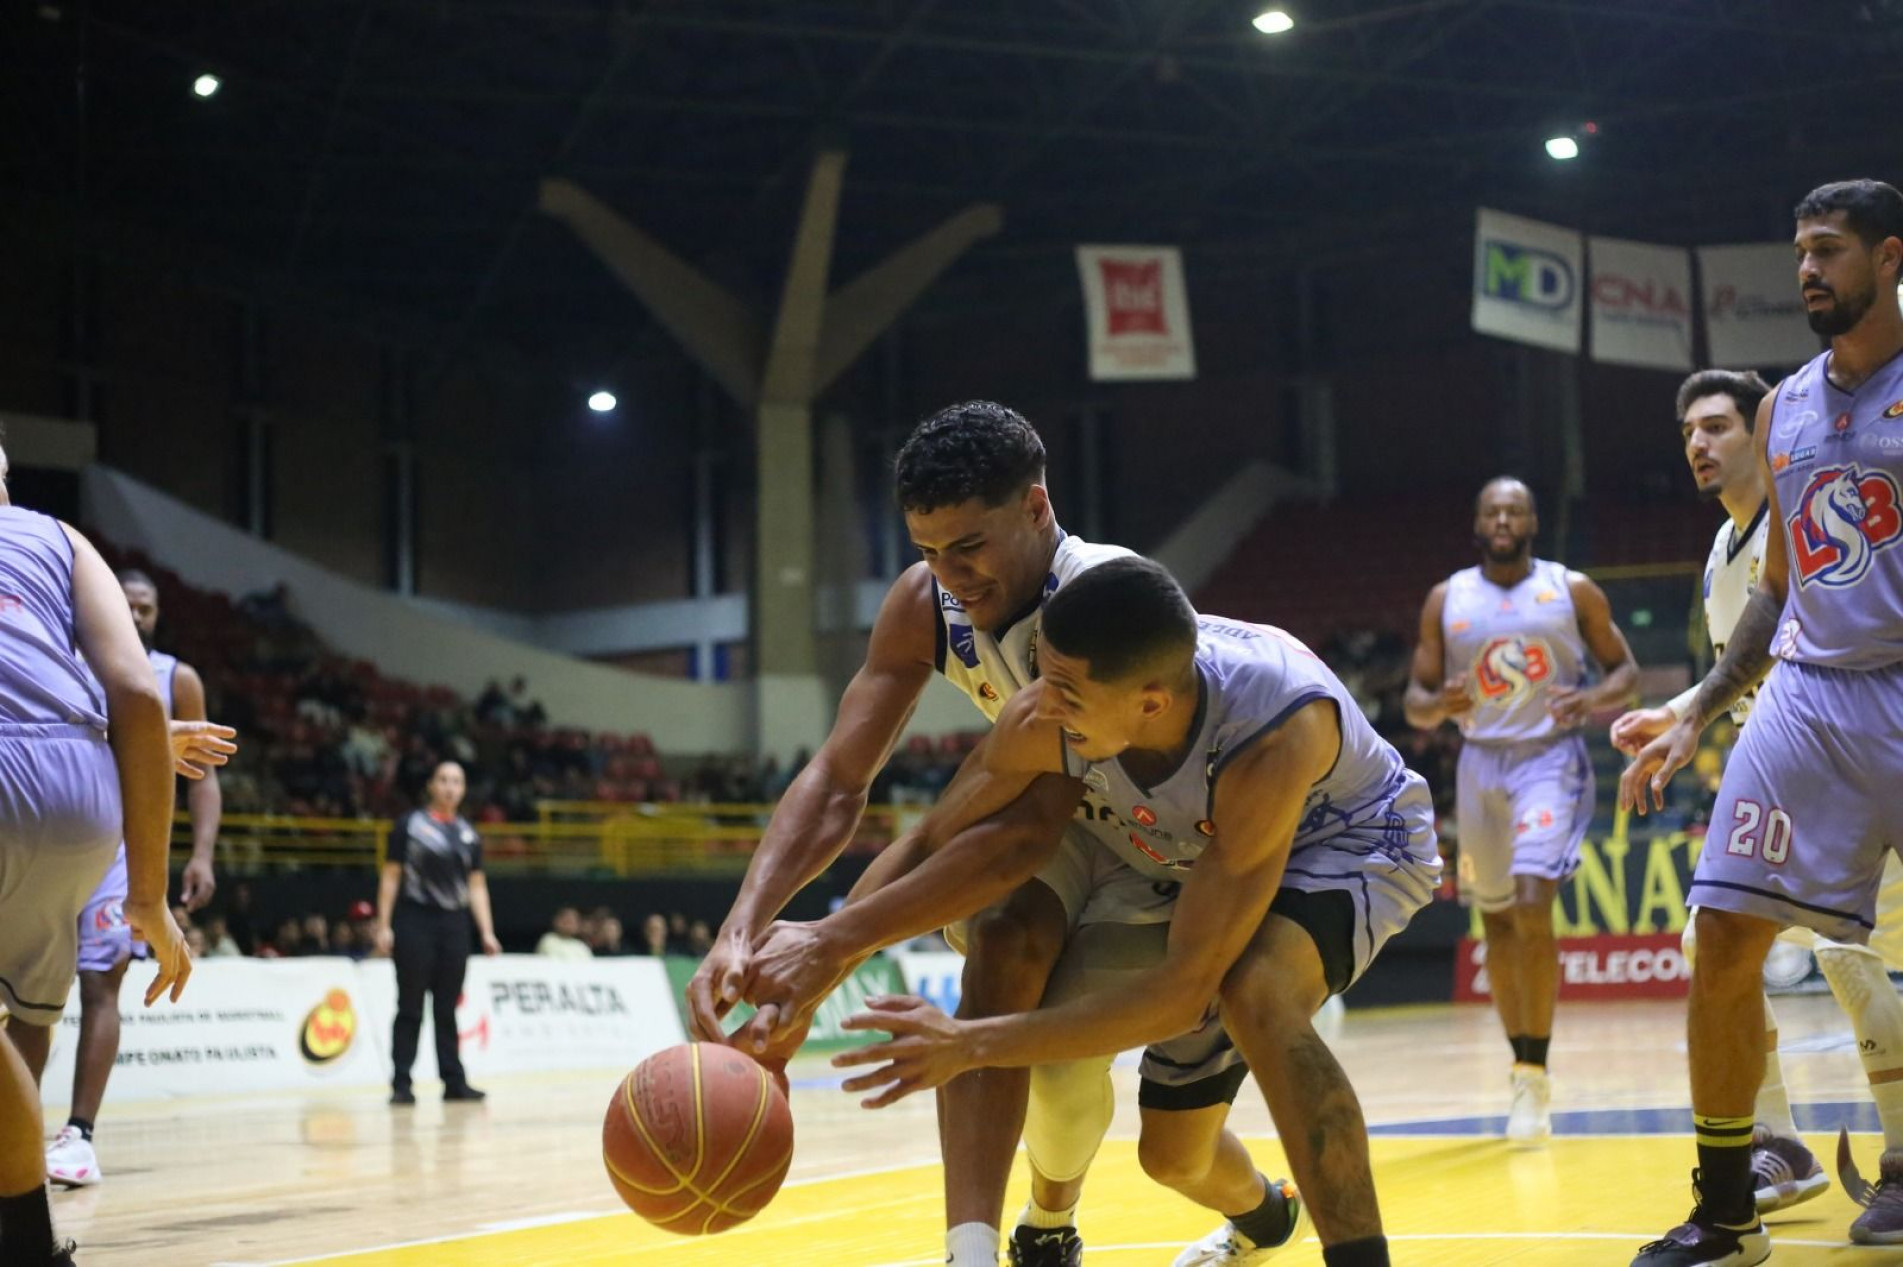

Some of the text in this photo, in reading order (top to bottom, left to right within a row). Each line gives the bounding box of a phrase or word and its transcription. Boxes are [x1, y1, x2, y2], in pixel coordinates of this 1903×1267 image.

[1485, 242, 1575, 310] MD
[1726, 799, 1792, 868] 20
[489, 979, 631, 1016] PERALTA
